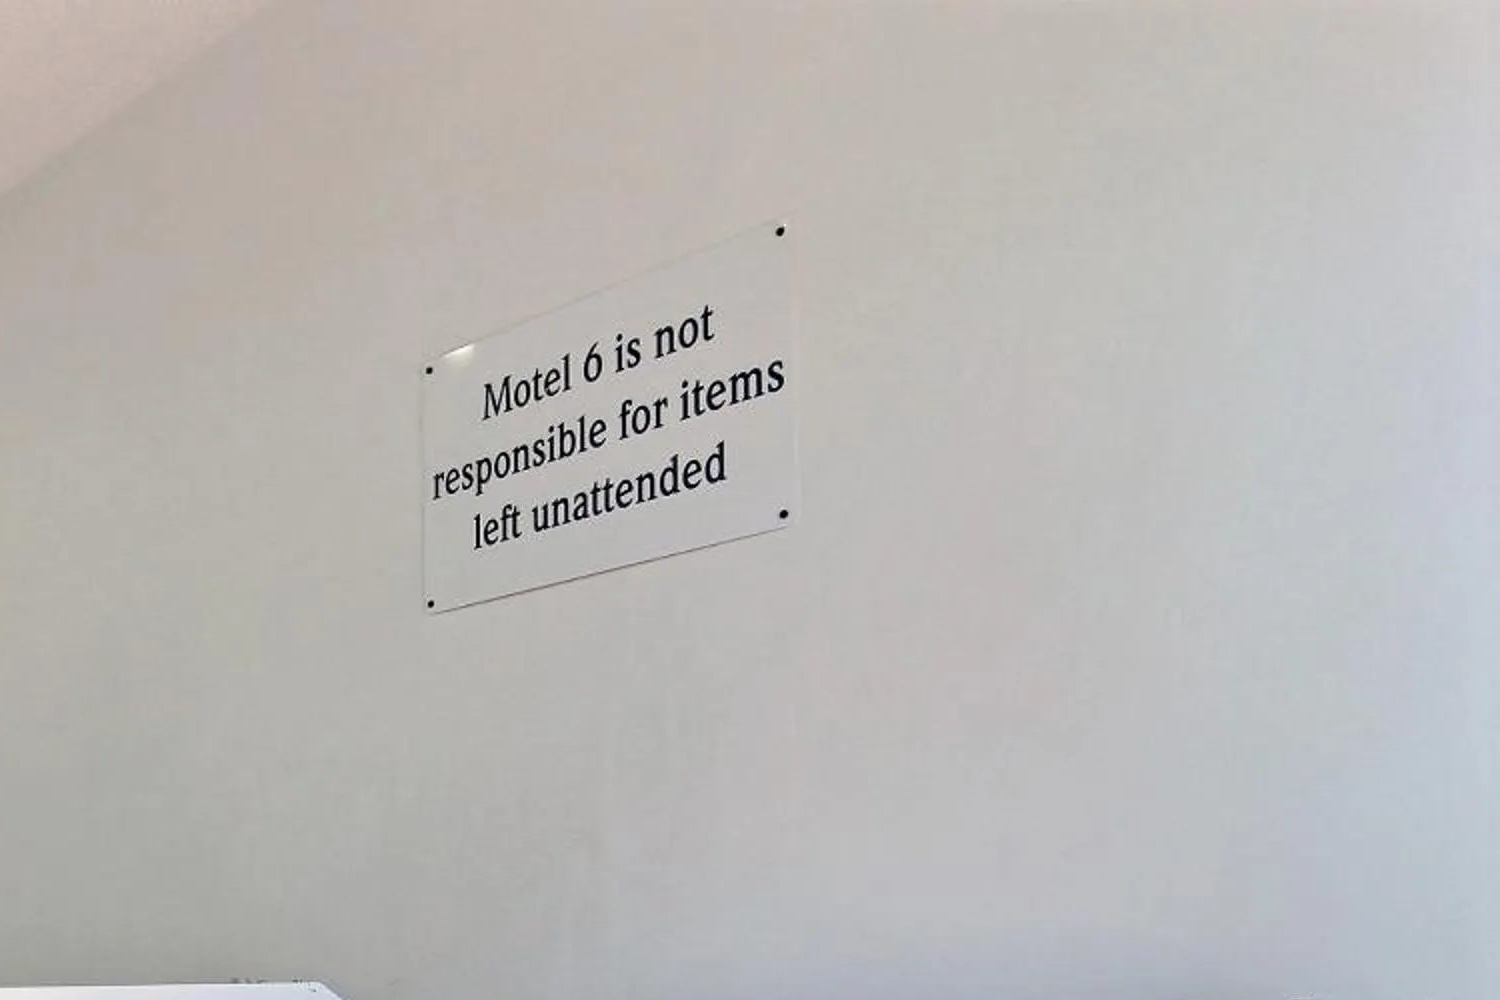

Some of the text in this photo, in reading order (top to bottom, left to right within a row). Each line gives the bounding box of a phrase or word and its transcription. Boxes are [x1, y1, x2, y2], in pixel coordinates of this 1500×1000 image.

[481, 304, 715, 421] Motel 6 is not
[432, 358, 785, 500] responsible for items
[472, 440, 727, 550] left unattended
